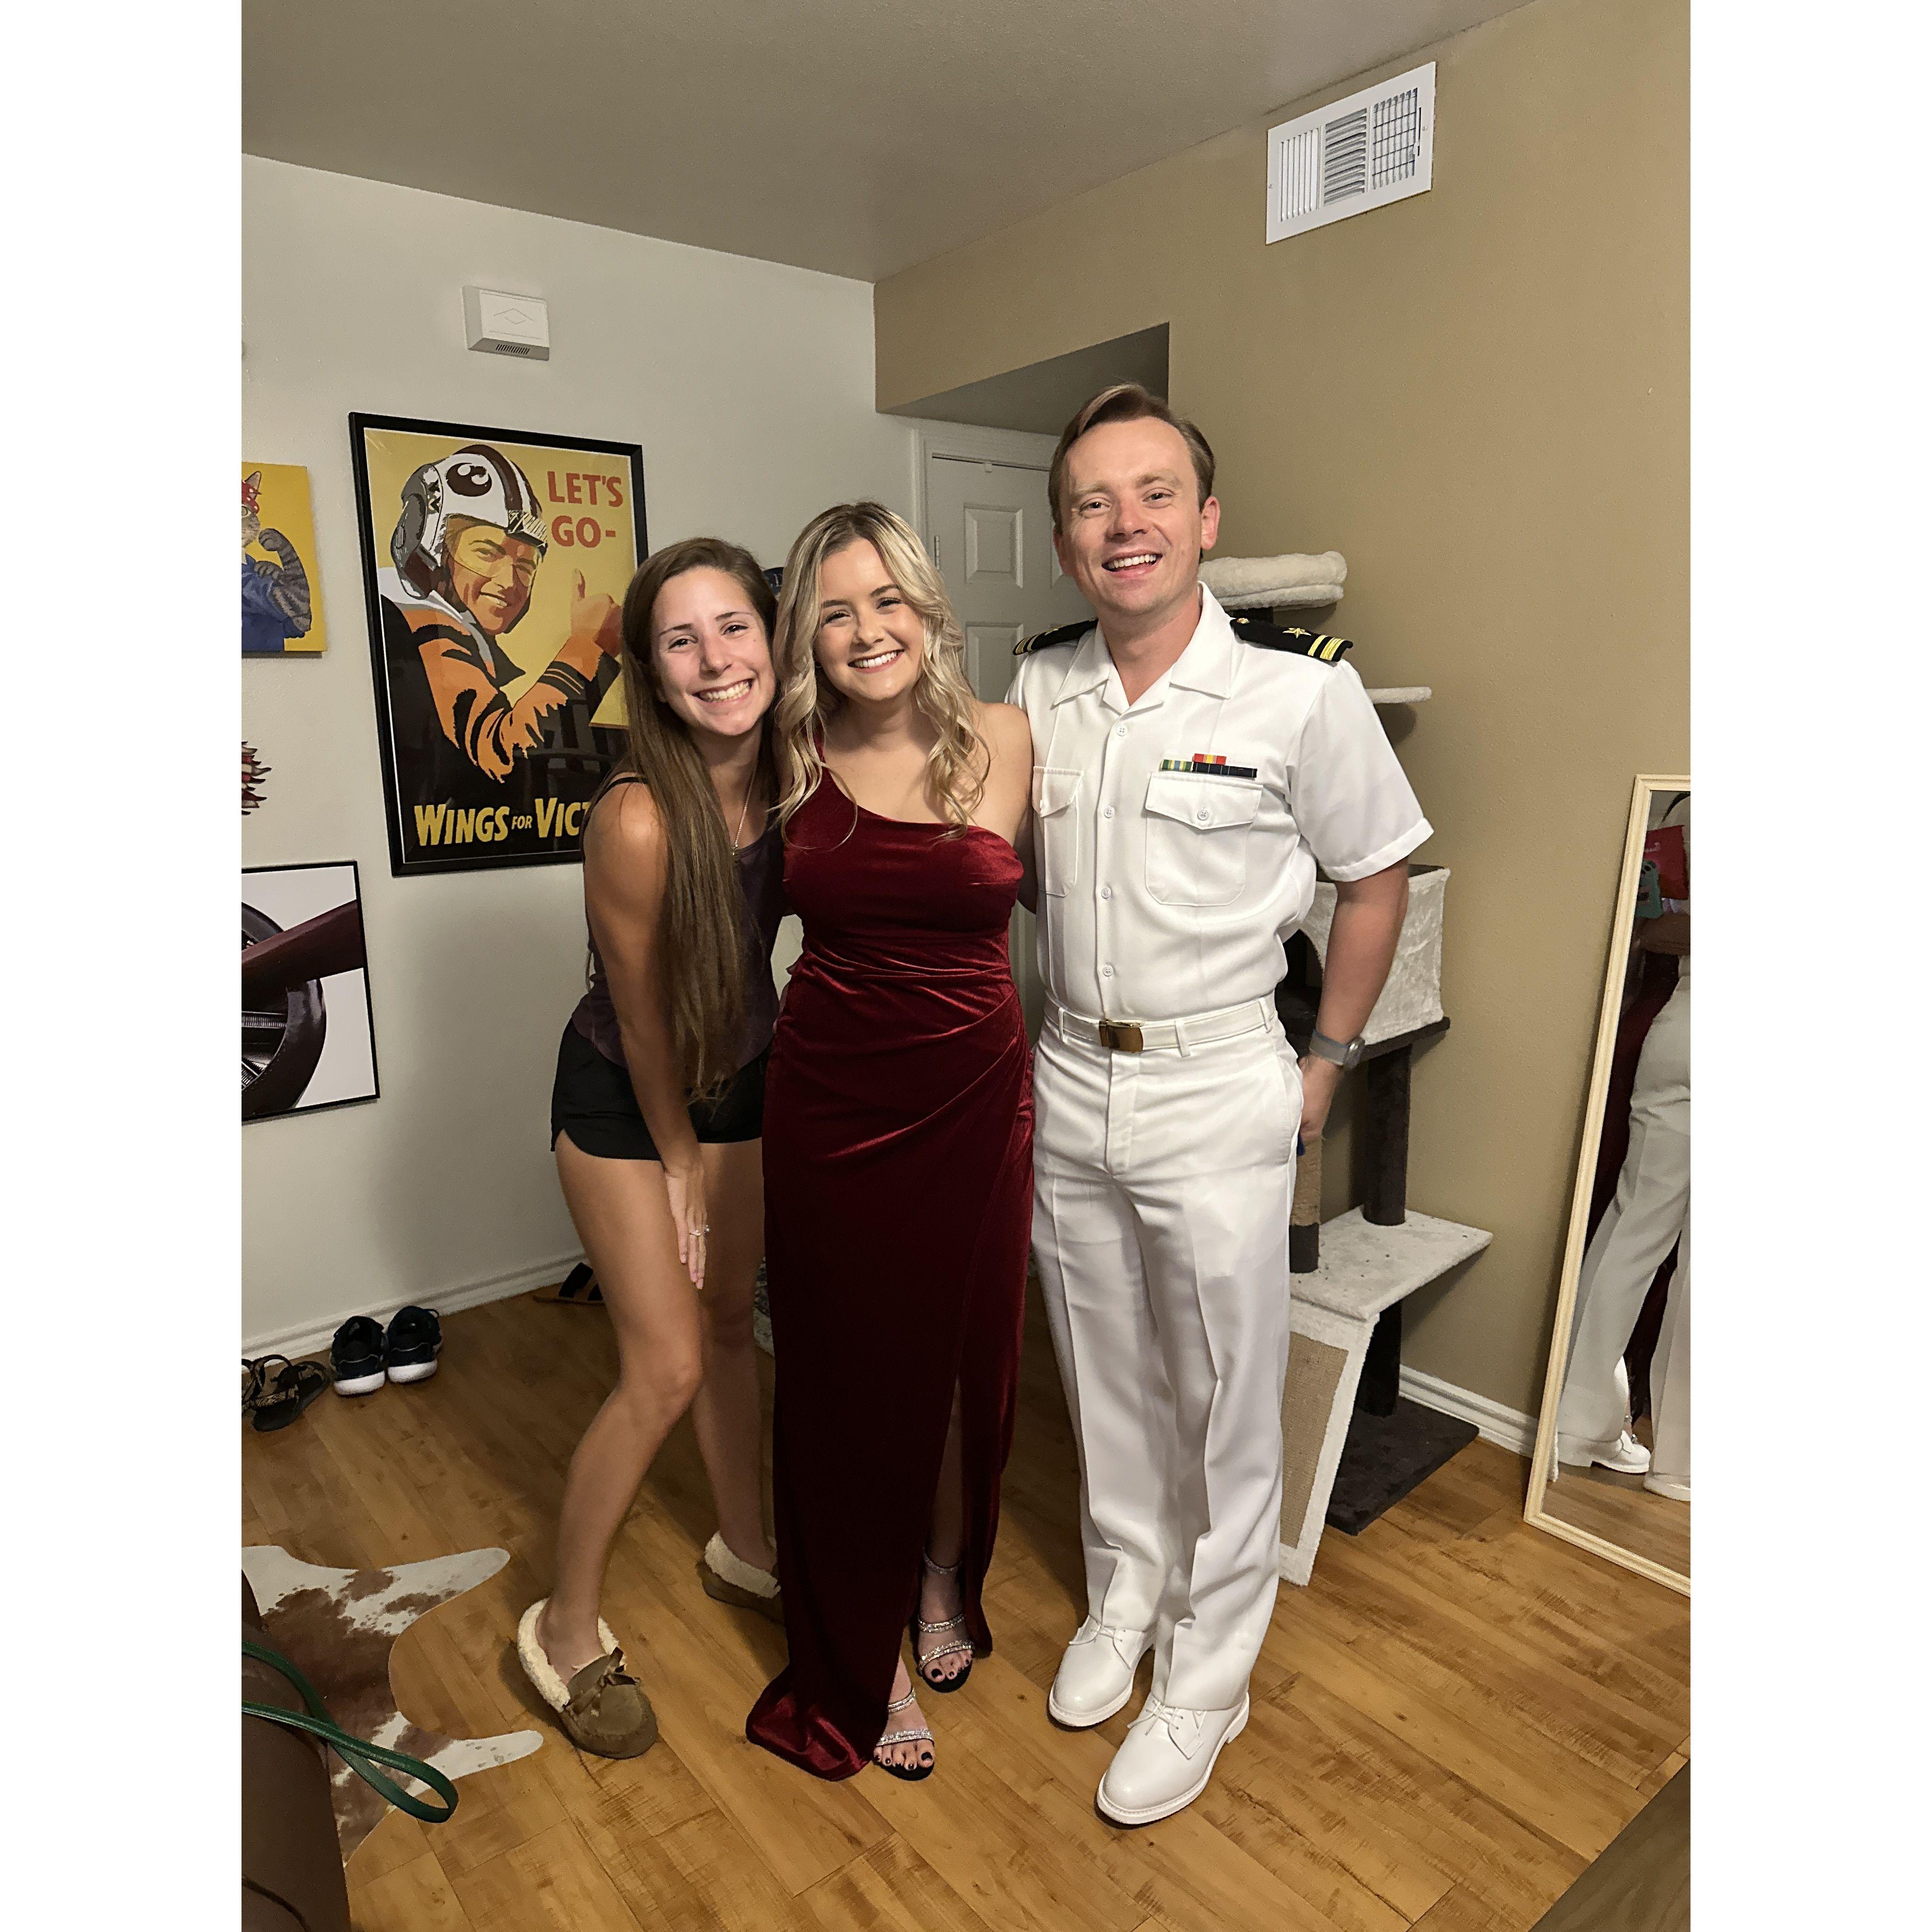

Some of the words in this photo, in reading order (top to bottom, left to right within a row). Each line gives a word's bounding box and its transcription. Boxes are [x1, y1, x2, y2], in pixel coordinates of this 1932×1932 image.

[547, 471, 623, 507] LET'S
[414, 804, 510, 846] WINGS
[511, 816, 533, 830] FOR
